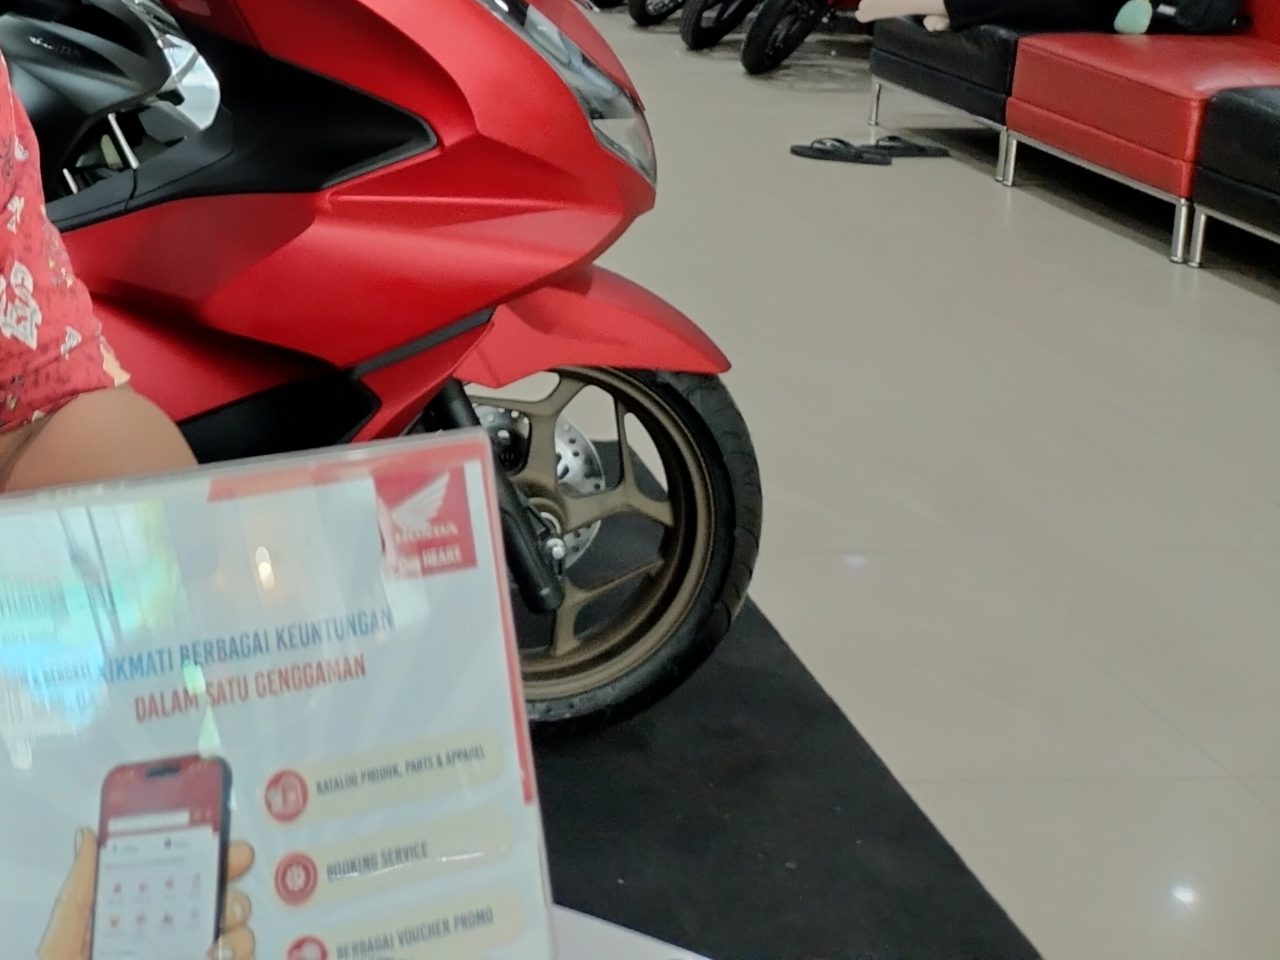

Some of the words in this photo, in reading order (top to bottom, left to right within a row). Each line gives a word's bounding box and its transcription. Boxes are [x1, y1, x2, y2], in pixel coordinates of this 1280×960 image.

[180, 630, 270, 667] BERBAGAI
[275, 607, 396, 650] KEUNTUNGAN
[135, 688, 199, 723] DALAM
[206, 678, 249, 708] SATU
[254, 654, 367, 699] GENGGAMAN
[326, 851, 378, 882] BOOKING
[380, 840, 429, 868] SERVICE
[396, 917, 451, 948] VOUCHER
[453, 907, 494, 930] PROMO
